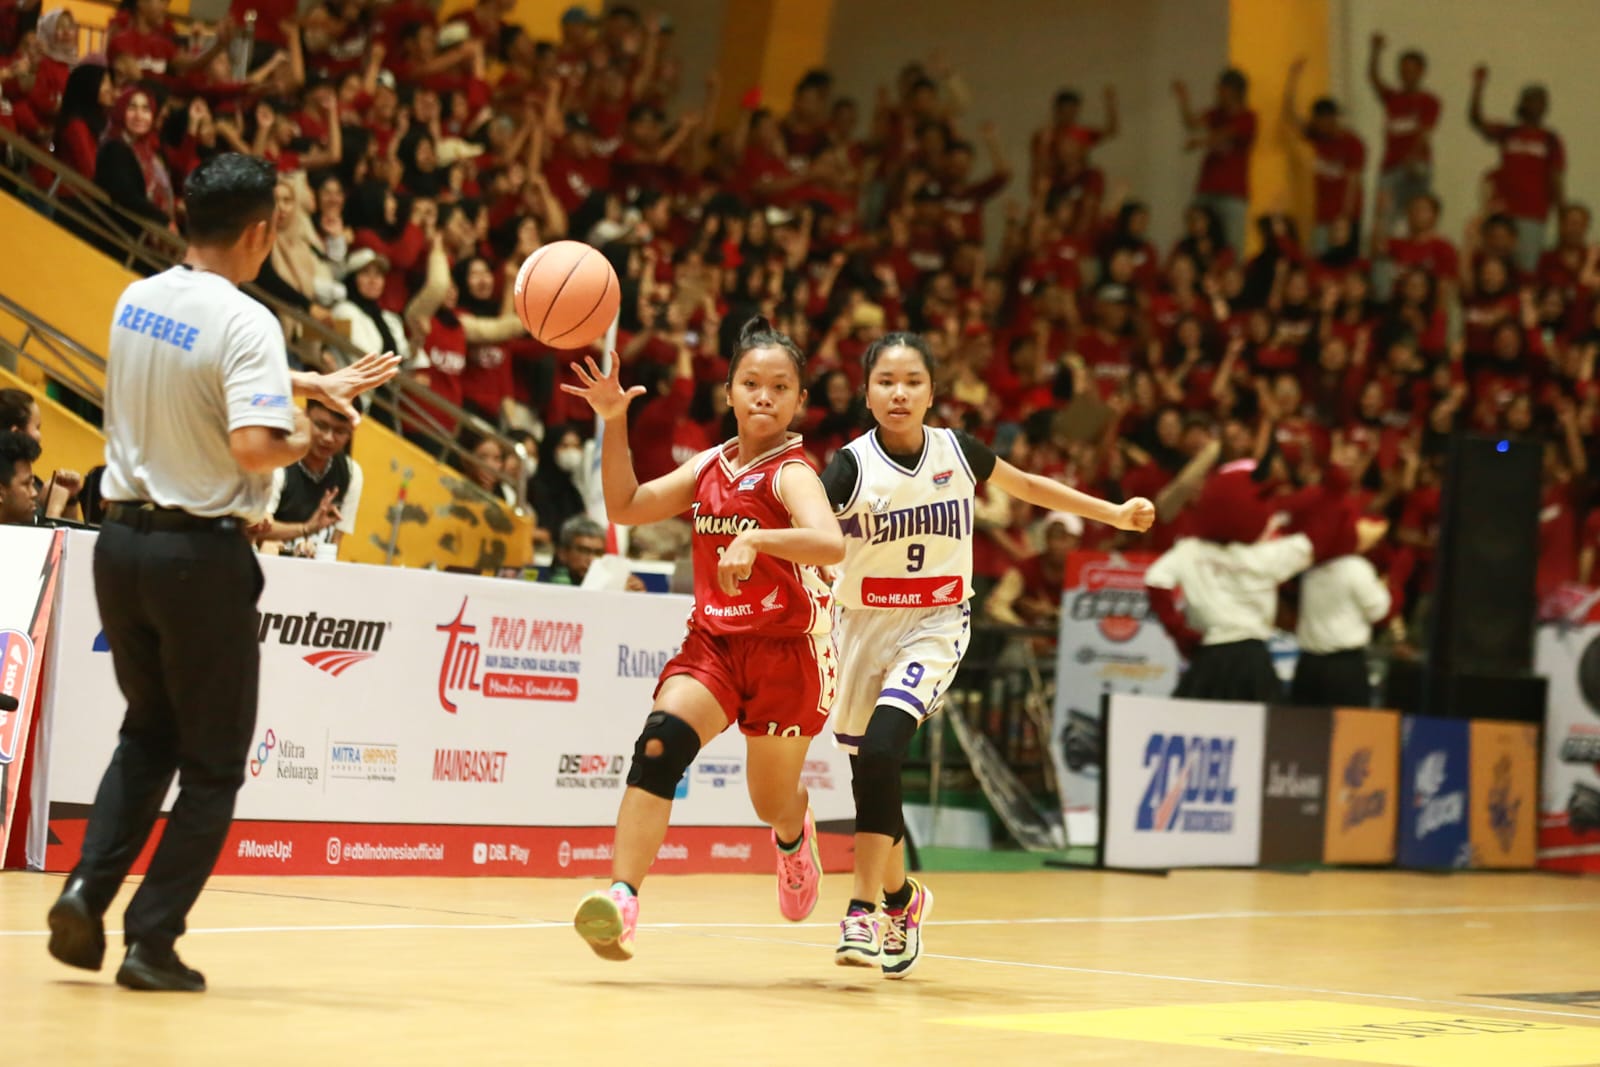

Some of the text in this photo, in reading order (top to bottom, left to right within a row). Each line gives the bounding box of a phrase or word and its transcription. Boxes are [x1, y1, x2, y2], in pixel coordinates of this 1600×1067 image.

[118, 304, 200, 352] REFEREE
[872, 499, 962, 545] SMADA
[906, 544, 925, 572] 9
[704, 603, 754, 617] One HEART.
[762, 602, 784, 612] HONDA
[867, 592, 922, 605] One HEART.
[258, 611, 386, 652] roteam
[488, 616, 584, 654] TRIO MOTOR
[901, 661, 926, 689] 9
[278, 739, 305, 759] Mitra
[331, 746, 361, 763] MITRA
[277, 760, 319, 785] Keluarga
[433, 748, 508, 783] MAINBASKET
[238, 840, 292, 862] #MoveUp!
[343, 843, 444, 861] @dblindonesiaofficial
[489, 843, 530, 865] DBL Play
